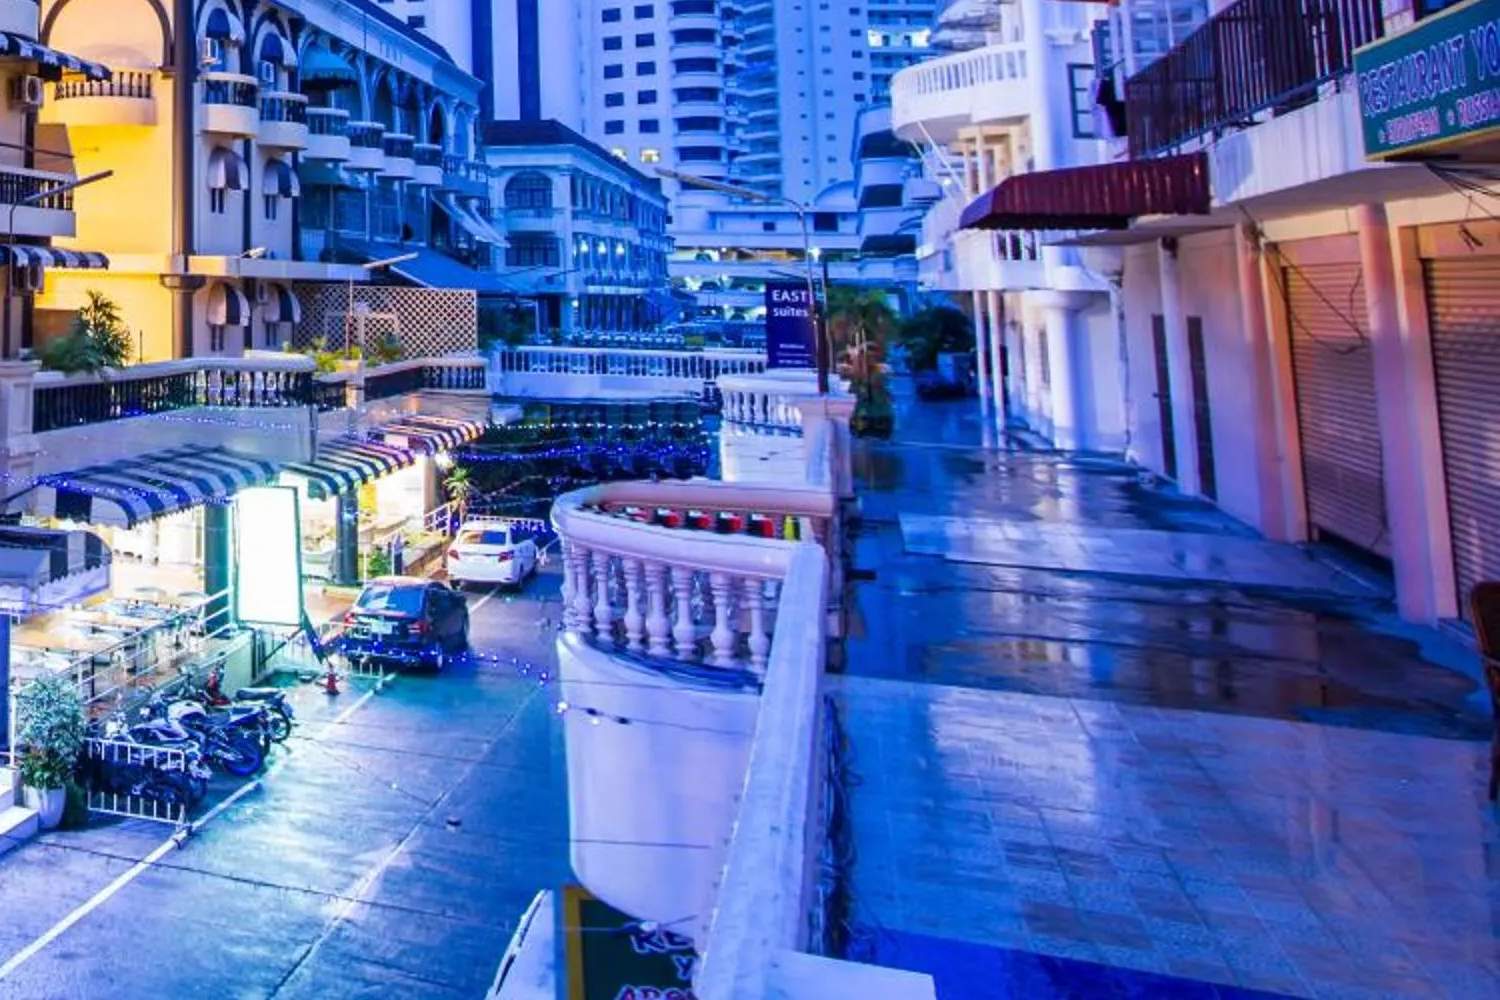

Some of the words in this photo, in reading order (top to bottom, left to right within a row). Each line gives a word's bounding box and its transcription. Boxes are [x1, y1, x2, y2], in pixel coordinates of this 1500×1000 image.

[1361, 34, 1466, 118] RESTAURANT
[1469, 18, 1500, 81] YO
[772, 289, 808, 302] EAST
[773, 306, 809, 317] suites
